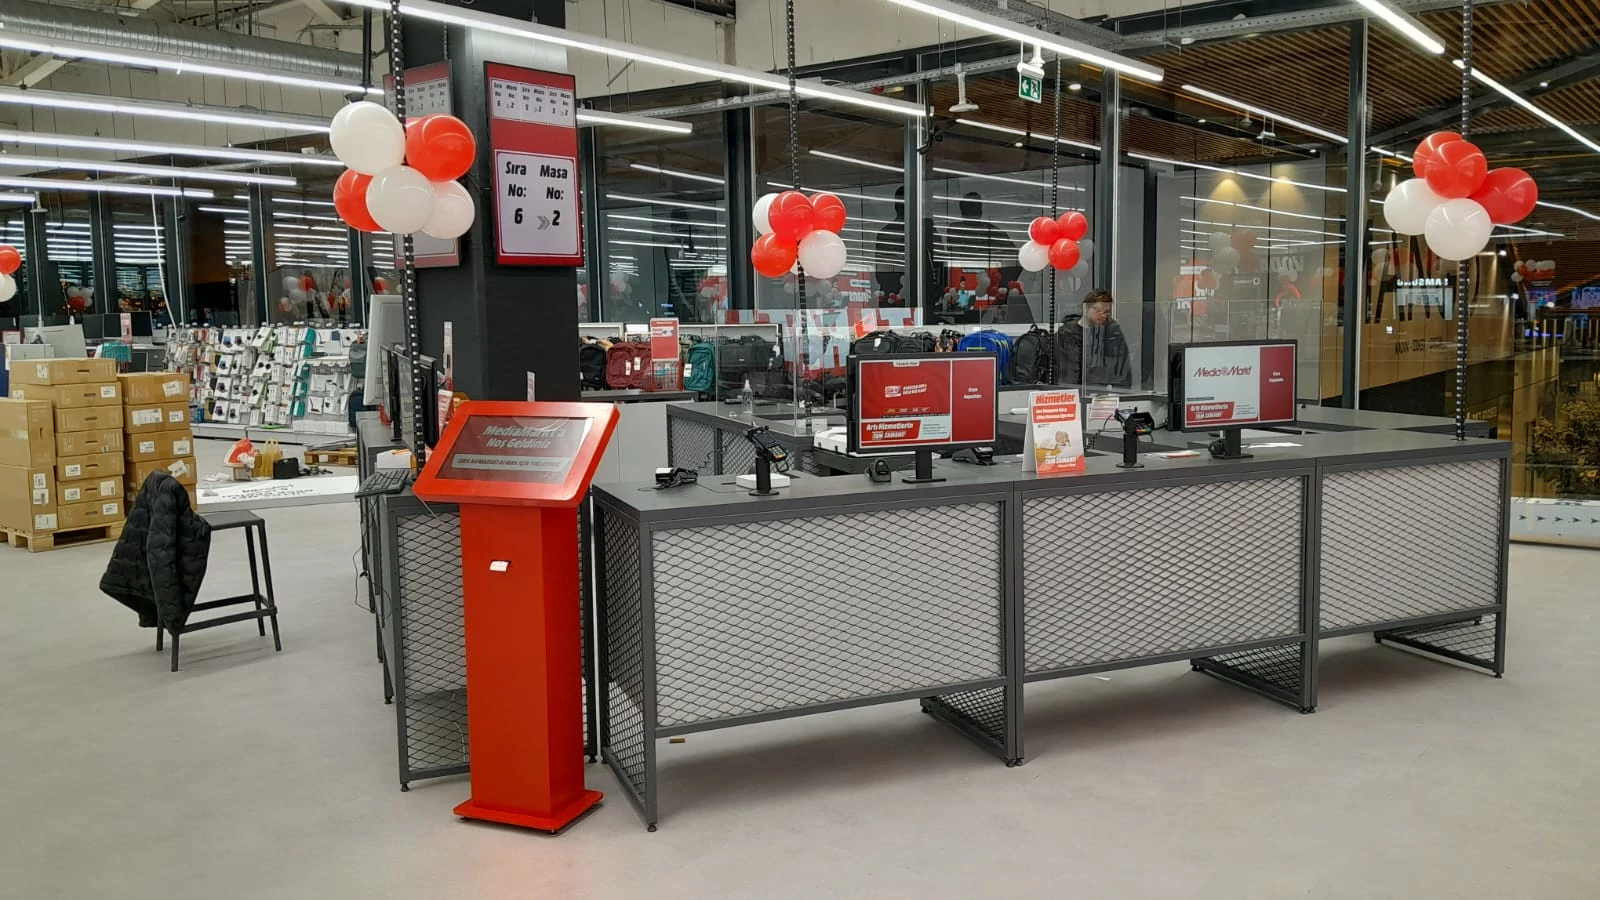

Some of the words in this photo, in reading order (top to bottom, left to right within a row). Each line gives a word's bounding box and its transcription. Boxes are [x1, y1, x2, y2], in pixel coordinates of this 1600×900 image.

[505, 161, 526, 175] Sıra
[540, 165, 568, 179] Masa
[508, 184, 527, 197] No:
[546, 187, 564, 200] No:
[514, 208, 523, 224] 6
[552, 210, 560, 226] 2
[1036, 393, 1075, 404] Hizmetler
[486, 438, 505, 449] Hoş
[506, 439, 552, 448] Geldiniz
